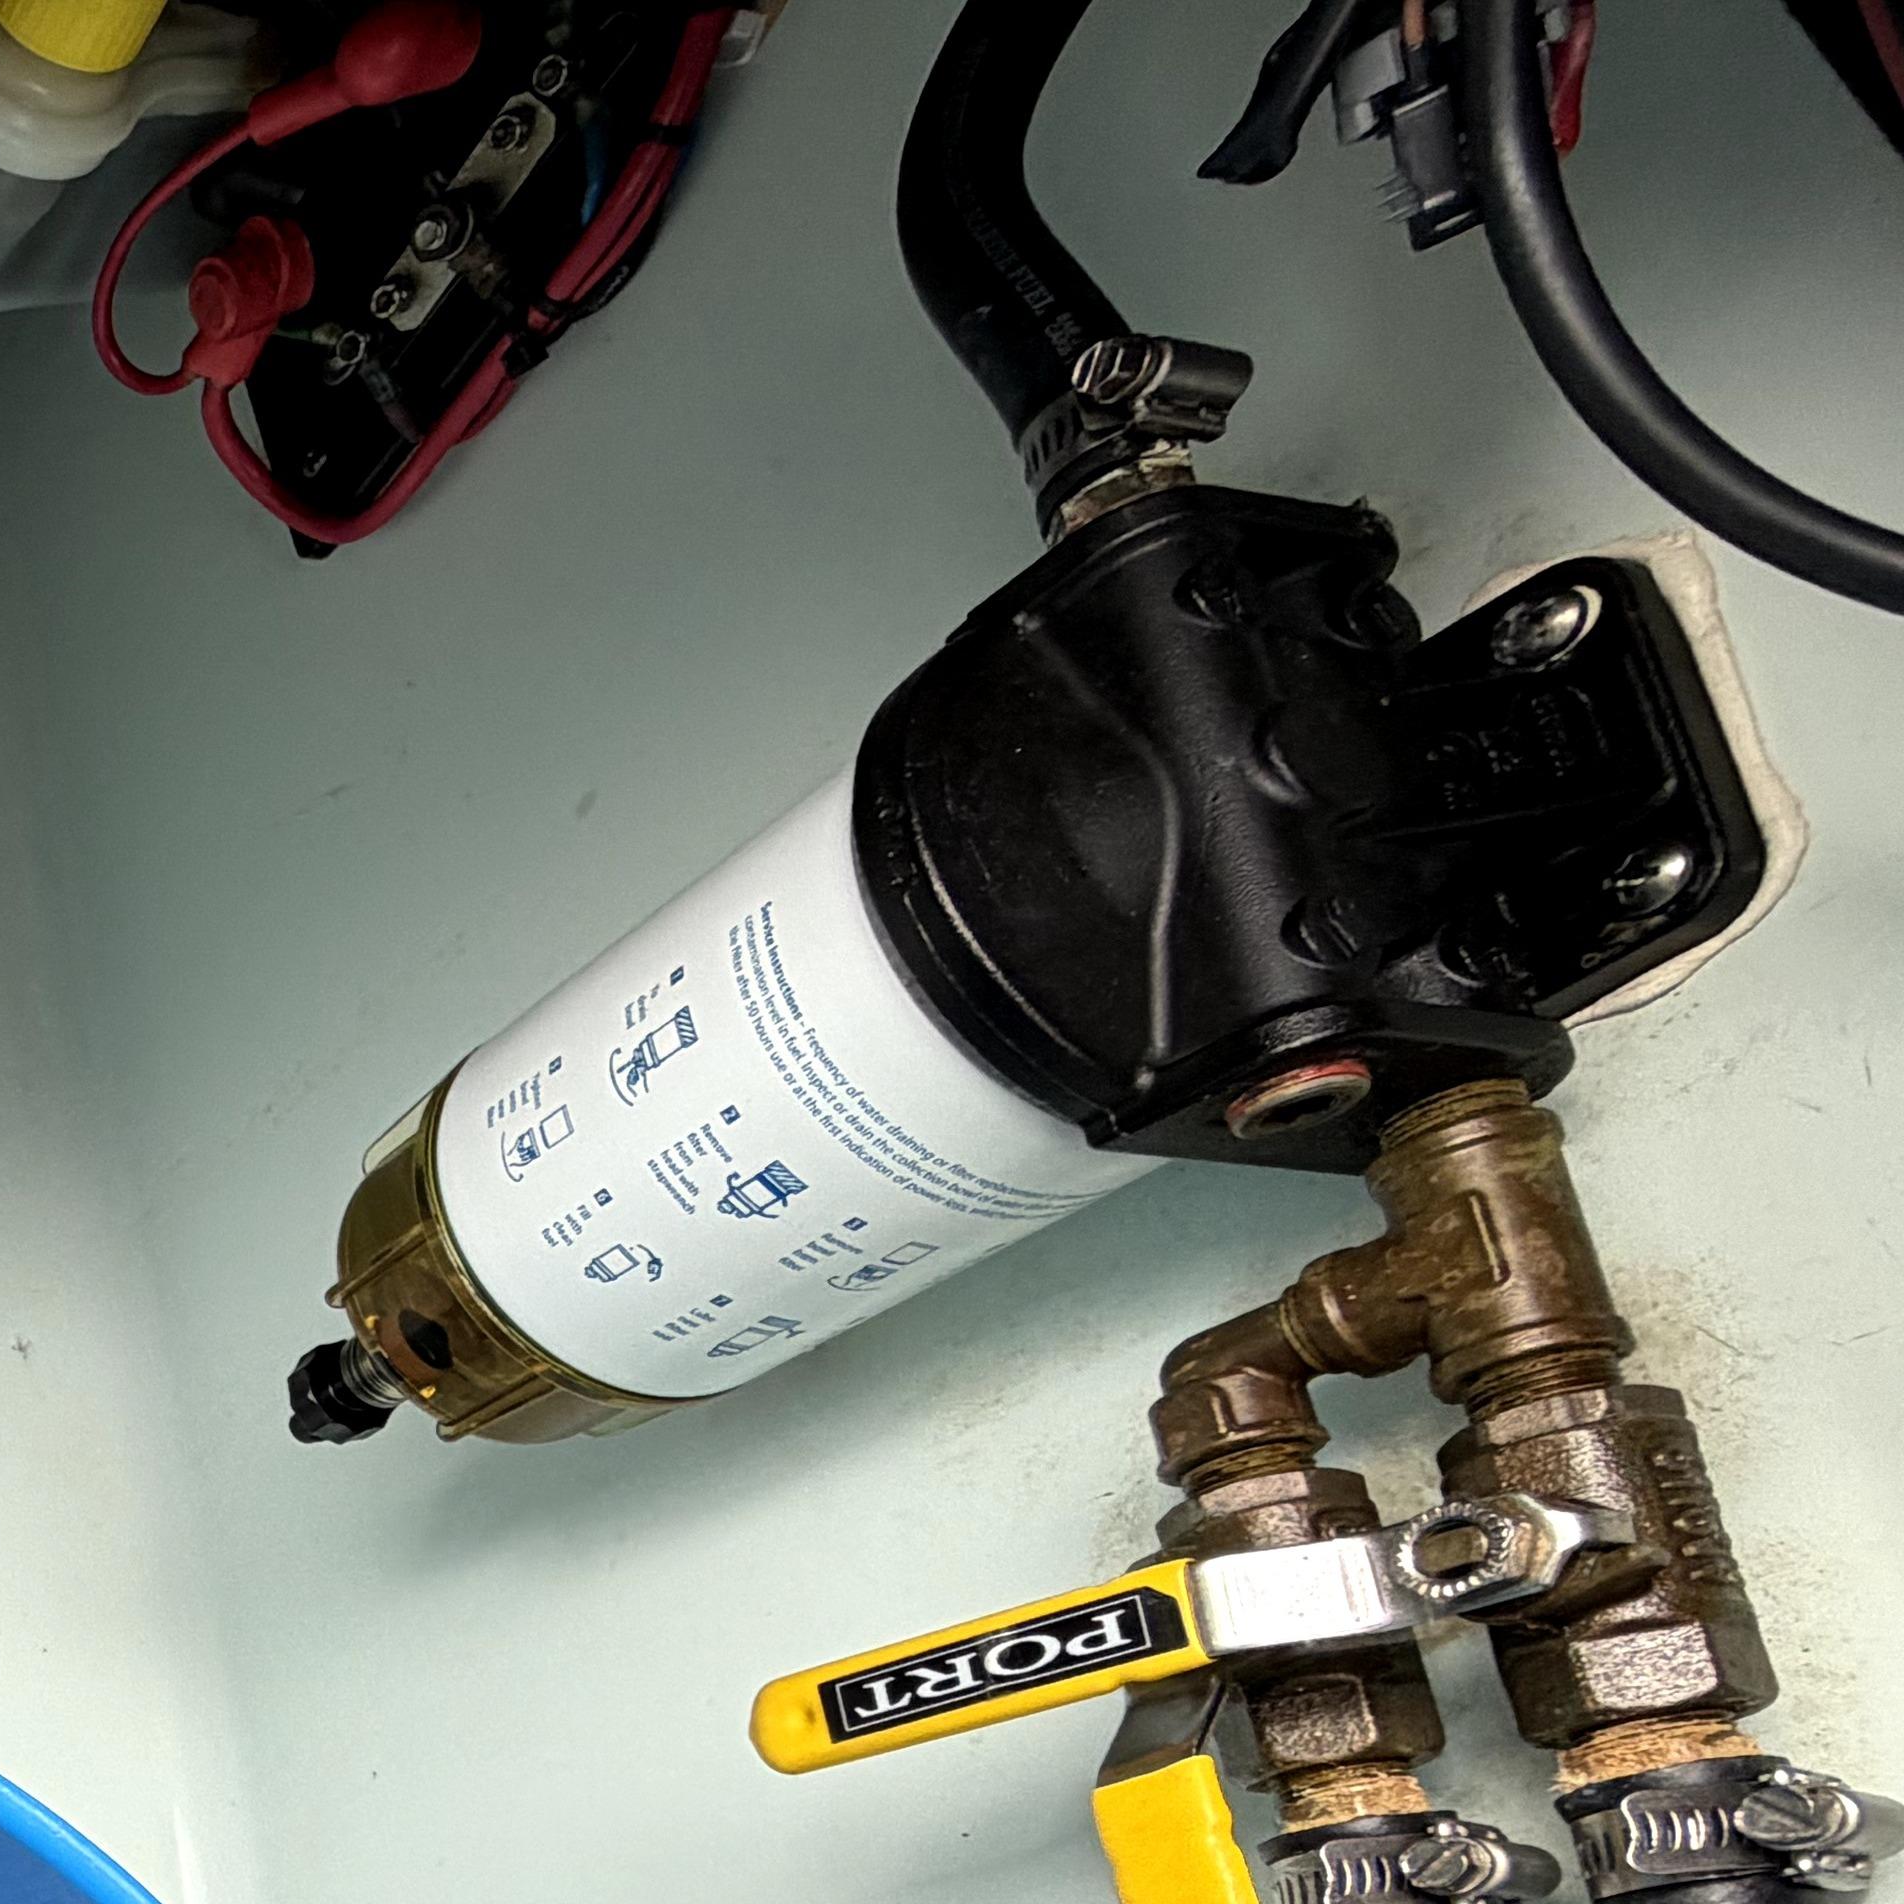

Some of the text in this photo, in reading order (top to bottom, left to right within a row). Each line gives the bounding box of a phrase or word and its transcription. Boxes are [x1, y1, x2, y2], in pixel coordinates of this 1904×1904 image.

[735, 973, 753, 1001] after
[744, 999, 760, 1018] 50
[751, 1016, 774, 1052] hours
[760, 900, 774, 947] Service
[768, 945, 802, 1020] Instructions
[803, 1027, 849, 1087] Frequency
[845, 1084, 864, 1099] of
[856, 1097, 886, 1127] water
[885, 1124, 934, 1162] draining
[932, 1156, 948, 1170] or
[948, 1164, 976, 1181] filter
[744, 915, 770, 996] contamination
[762, 994, 785, 1025] level
[777, 1023, 790, 1038] in
[800, 1061, 838, 1104] Inspect
[832, 1101, 847, 1115] or
[845, 1112, 875, 1140] drain
[872, 1134, 896, 1159] the
[891, 1152, 947, 1188] collection
[769, 1051, 787, 1073] use
[782, 1072, 796, 1086] or
[792, 1084, 808, 1099] at
[802, 1096, 825, 1117] the
[818, 1114, 843, 1138] first
[673, 1140, 694, 1167] from
[686, 1131, 707, 1157] filter
[699, 1122, 732, 1164] Remove
[837, 1134, 895, 1181] indication
[660, 1148, 700, 1197] head with
[892, 1173, 909, 1185] of
[904, 1182, 943, 1203] power
[564, 1212, 583, 1235] with
[576, 1204, 591, 1221] Fill
[540, 1227, 557, 1248] fuel
[552, 1220, 573, 1246] clean
[854, 1608, 1133, 1717] PORT
